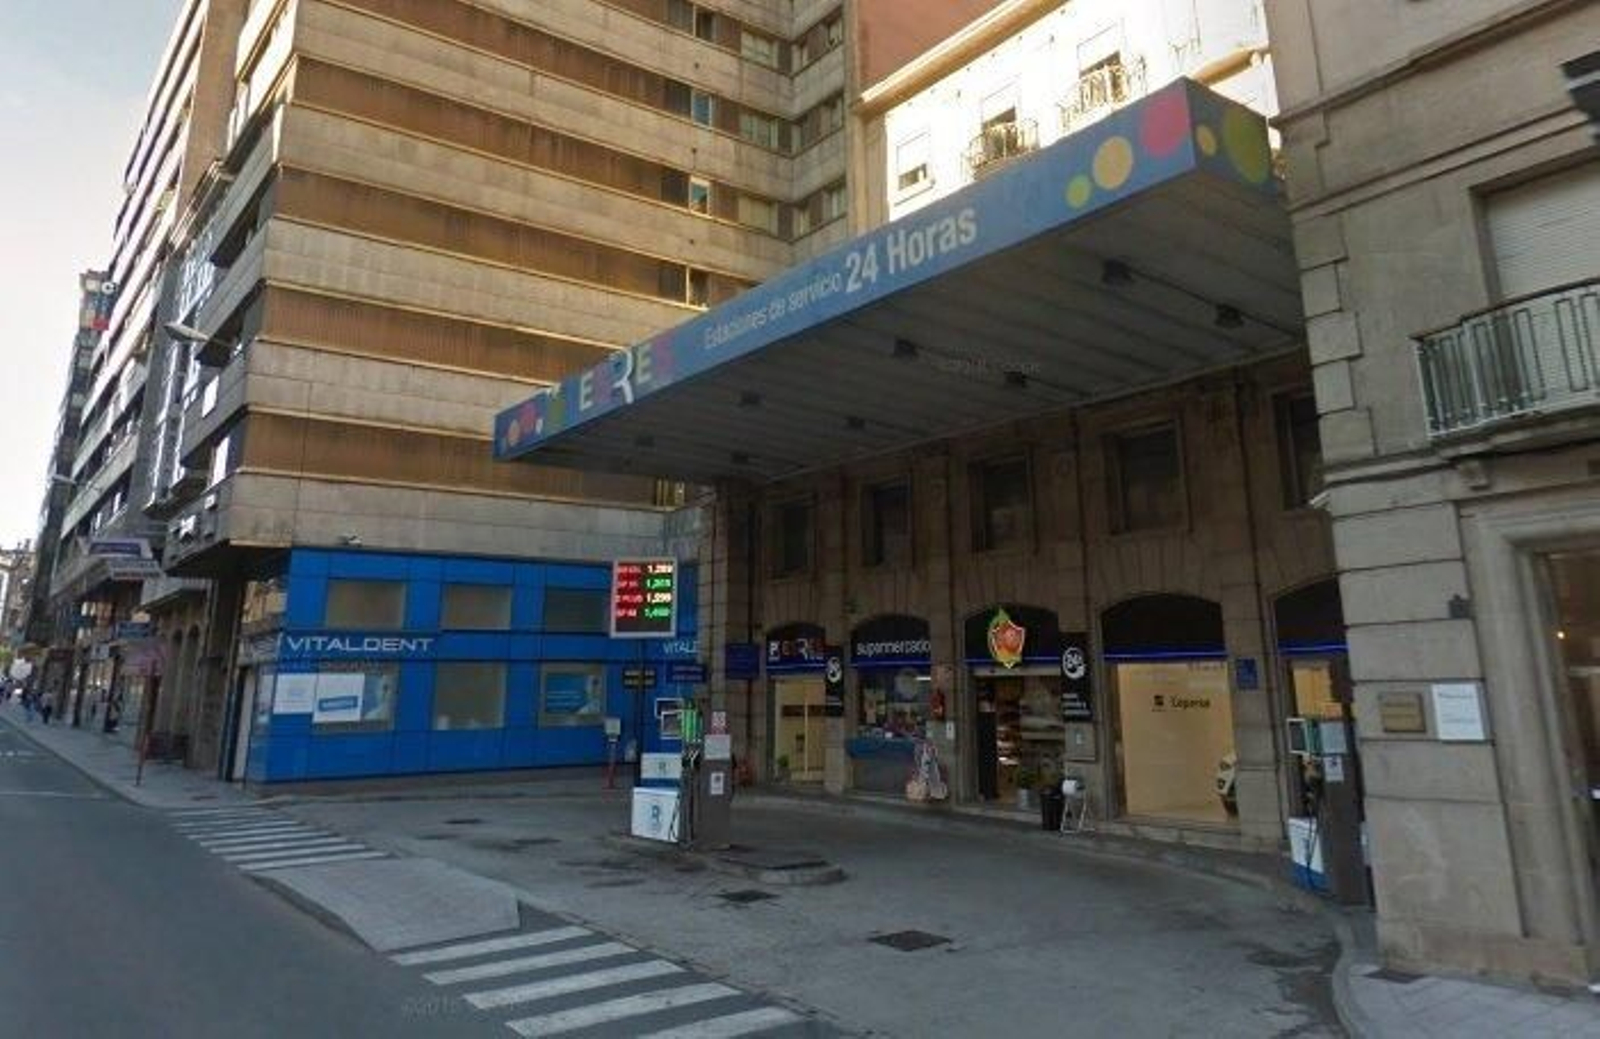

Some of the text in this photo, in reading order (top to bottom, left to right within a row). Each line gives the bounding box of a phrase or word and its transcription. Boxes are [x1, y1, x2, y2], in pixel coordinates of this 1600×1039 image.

[788, 272, 841, 311] servicio
[845, 244, 879, 293] 24
[887, 207, 977, 274] Horas
[287, 636, 434, 652] VITALDENT
[856, 638, 931, 658] supermercado
